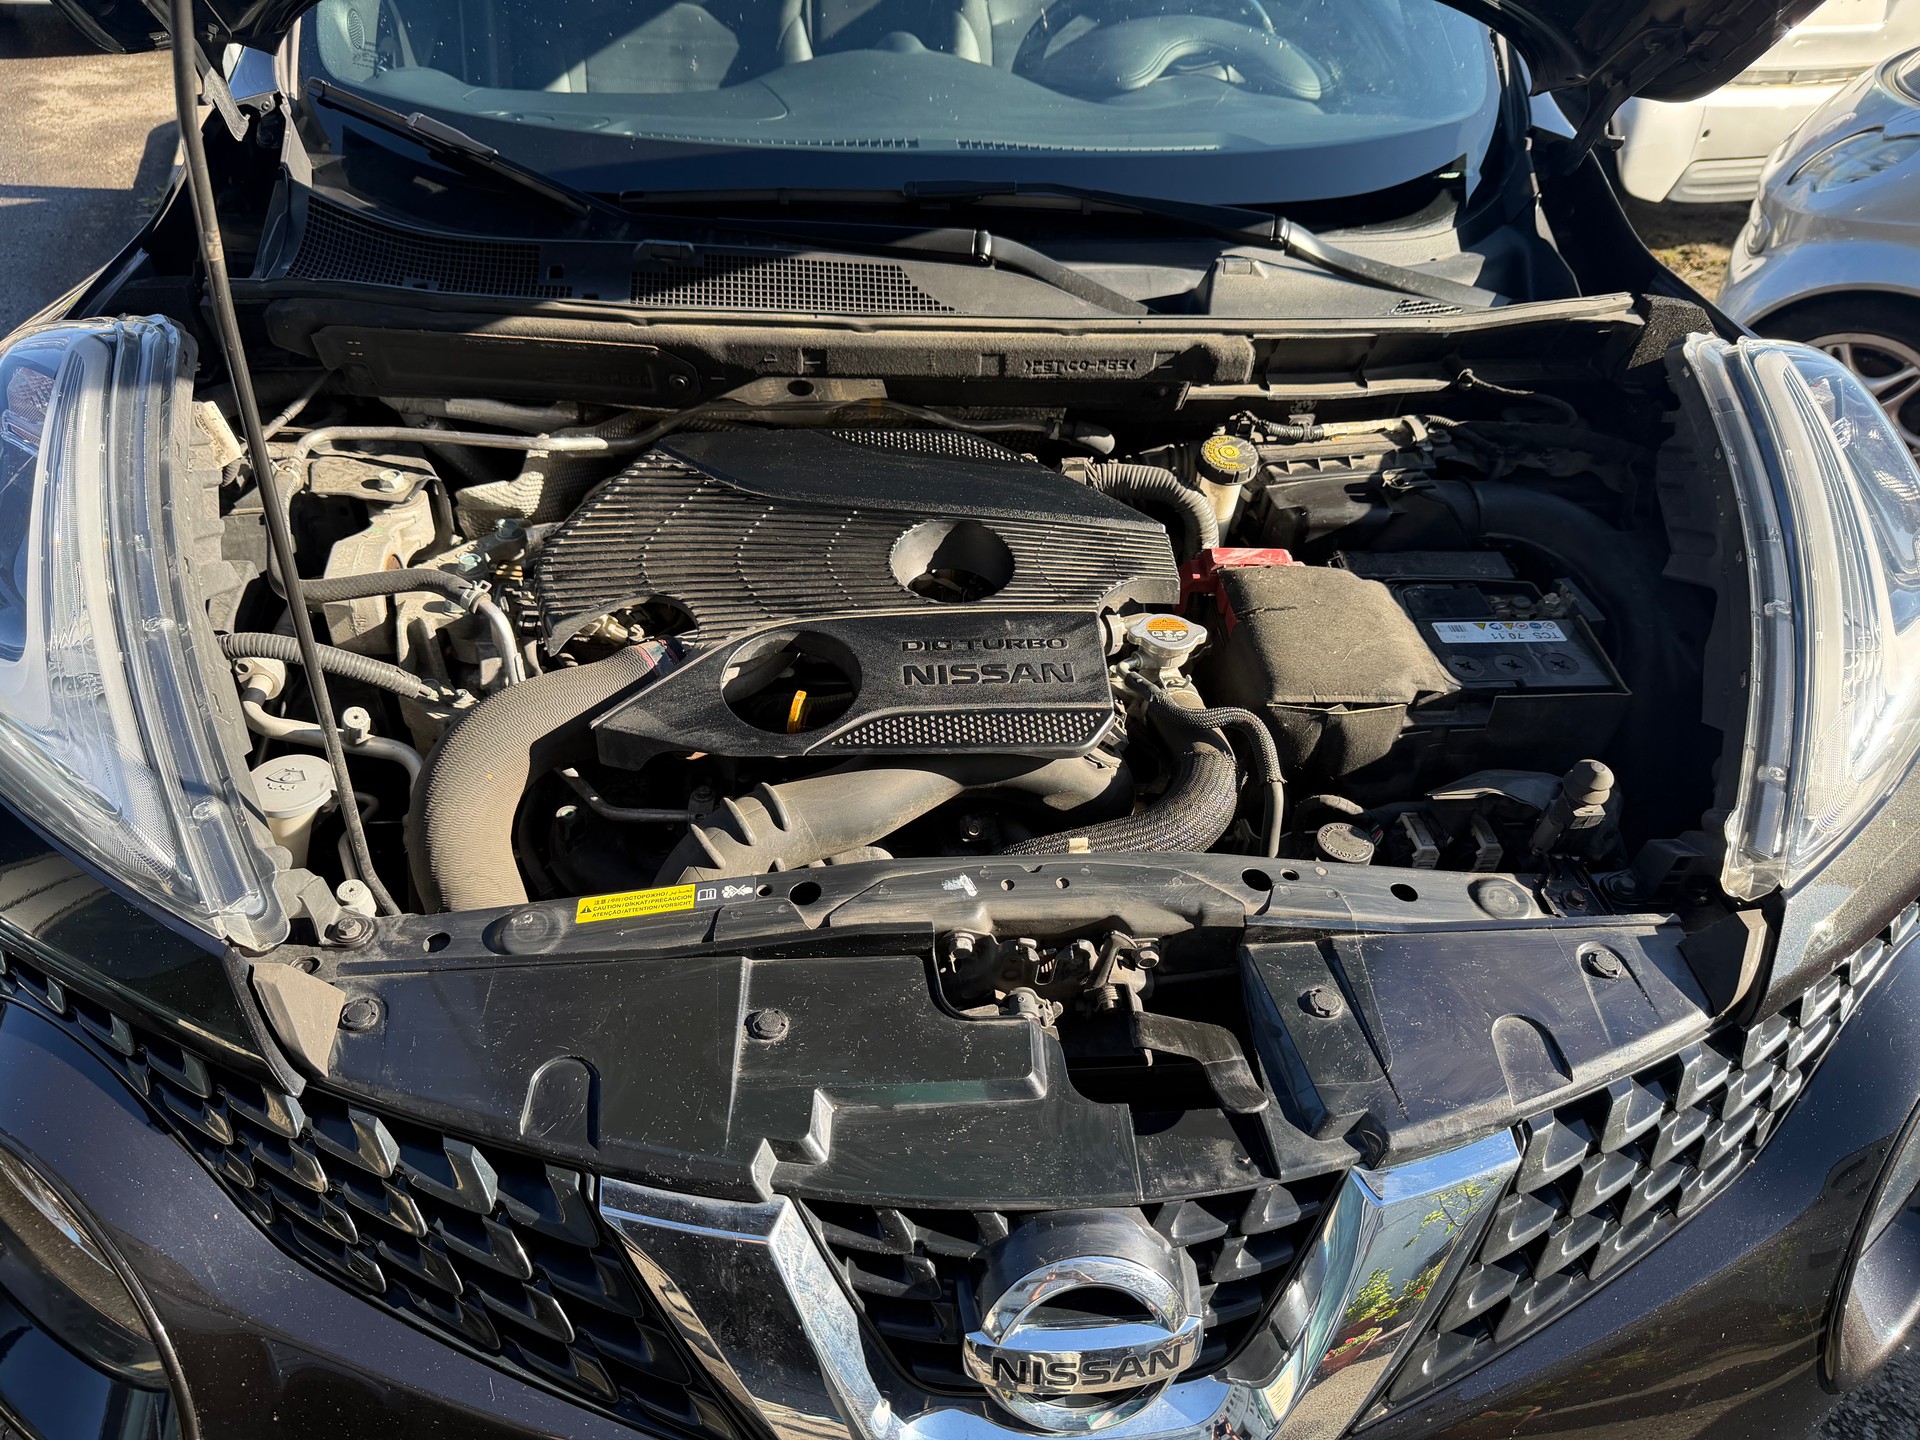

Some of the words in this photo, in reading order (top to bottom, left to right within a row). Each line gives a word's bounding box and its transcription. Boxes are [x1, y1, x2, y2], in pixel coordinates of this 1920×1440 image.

[902, 640, 952, 651] DIG
[960, 638, 1069, 651] TURBO
[903, 662, 1075, 687] NISSAN
[992, 1343, 1181, 1386] NISSAN
